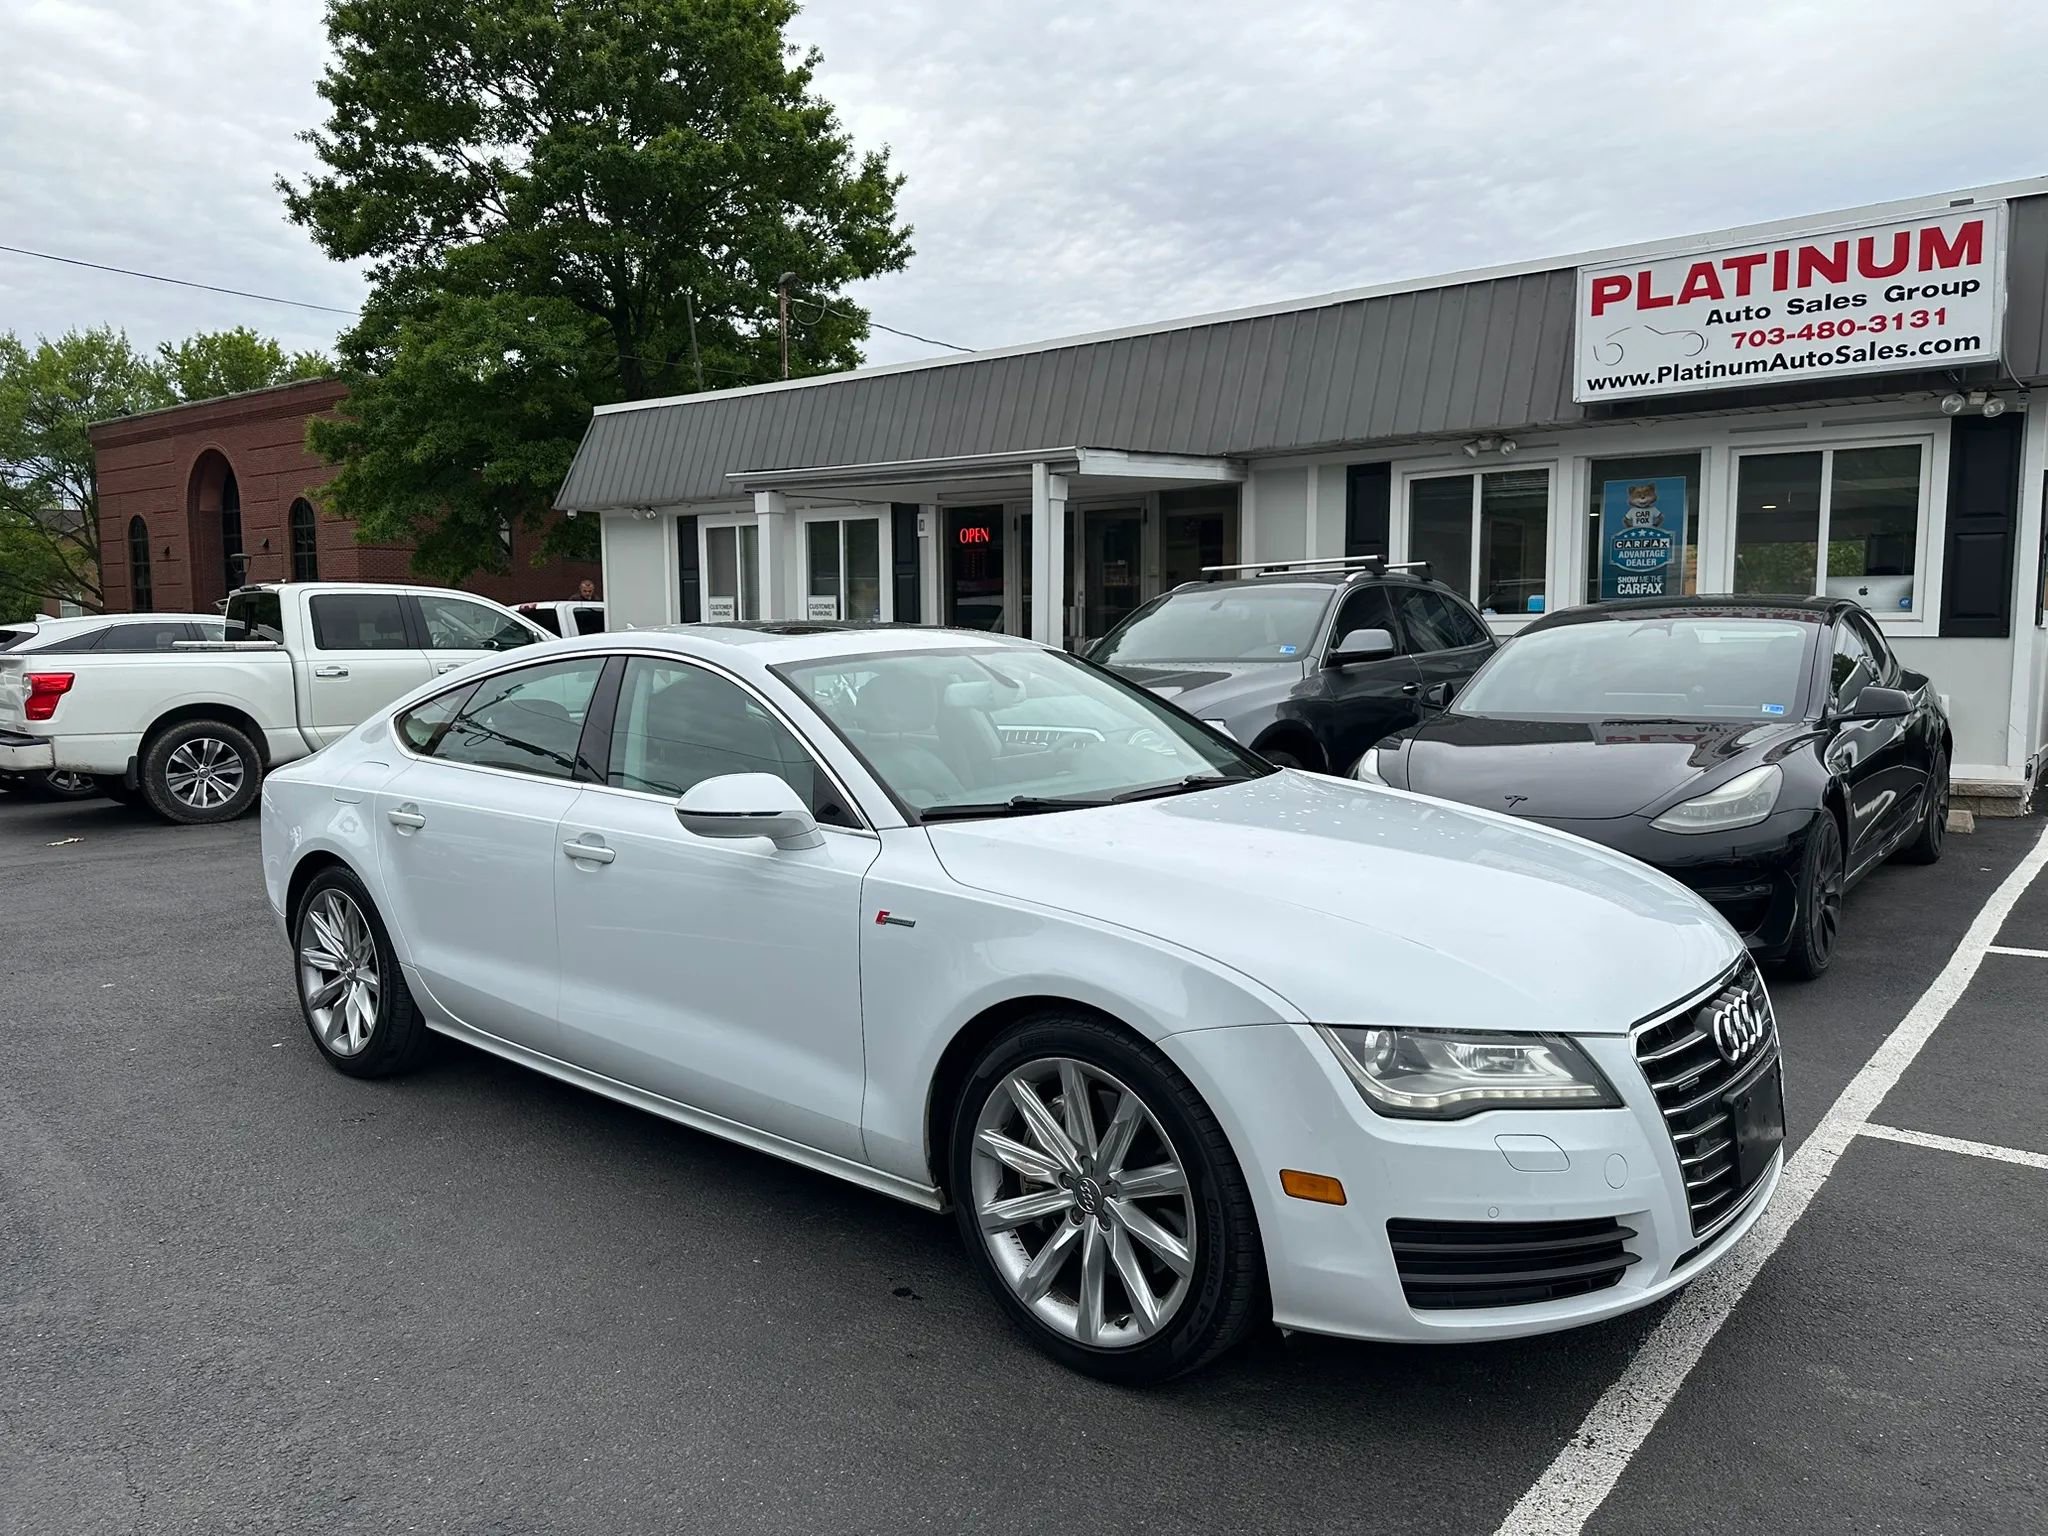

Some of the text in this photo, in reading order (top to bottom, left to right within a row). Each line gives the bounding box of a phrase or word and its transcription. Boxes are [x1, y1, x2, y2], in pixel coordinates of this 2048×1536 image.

[1590, 219, 1985, 317] PLATINUM
[1705, 277, 1981, 327] Auto Sales Group
[1731, 307, 1947, 350] 703-480-3131
[1587, 333, 1981, 391] www.PlatinumAutoSales.com
[1636, 517, 1650, 525] FOX
[959, 527, 990, 544] OPEN
[1615, 538, 1670, 549] CARFAX
[1618, 550, 1665, 558] ADVANTAGE
[1617, 575, 1663, 584] SHOW ME THE
[1617, 583, 1662, 594] CARFAX
